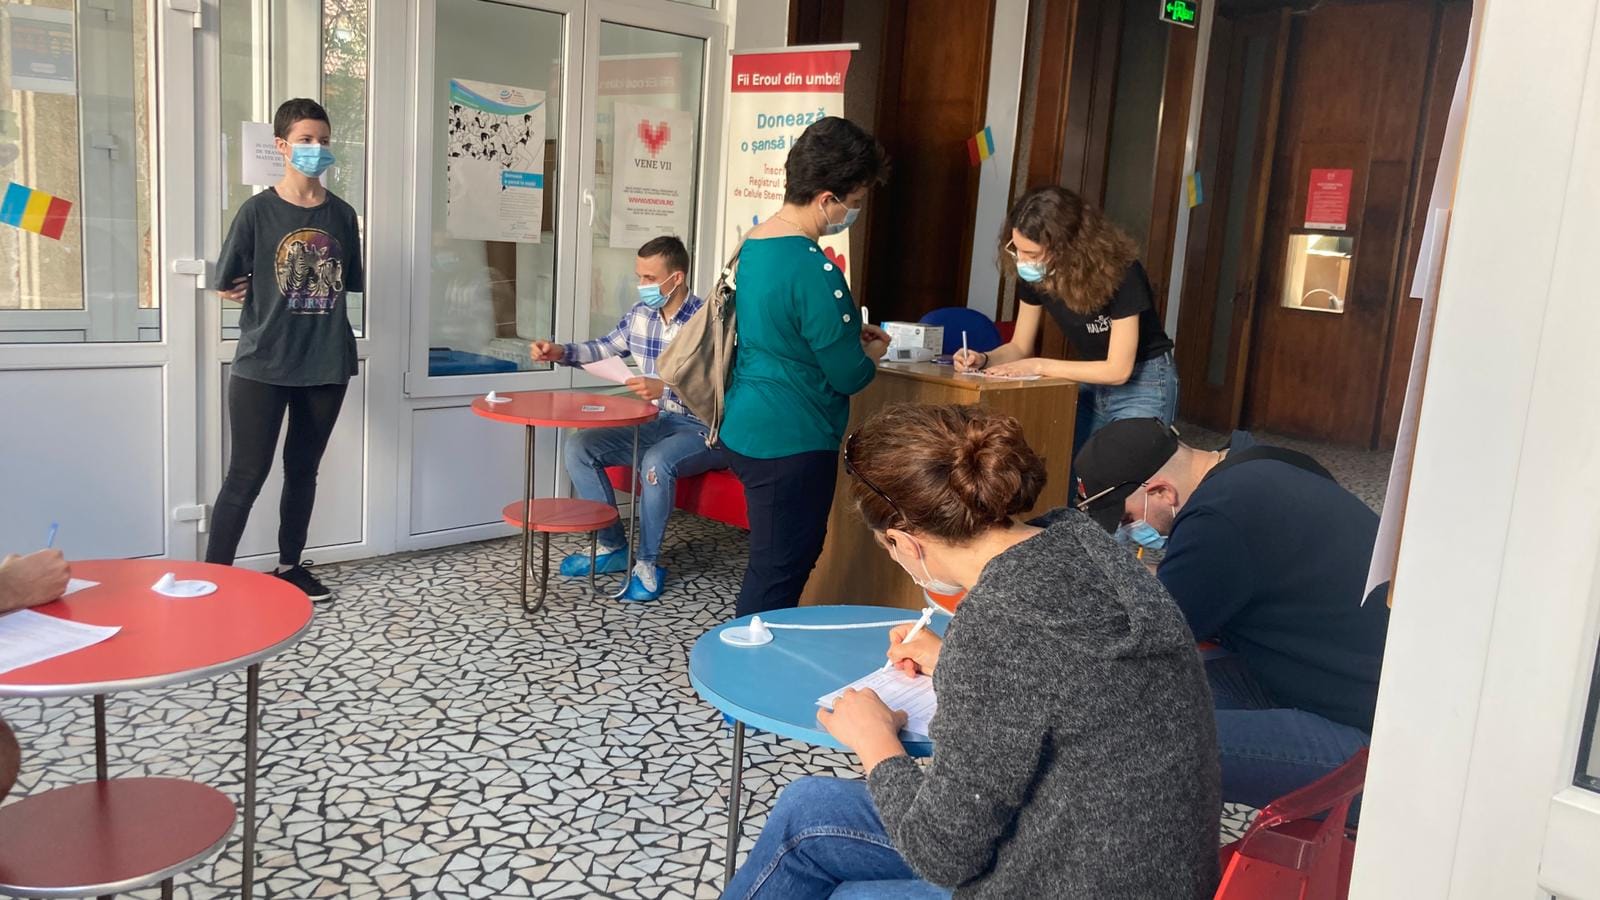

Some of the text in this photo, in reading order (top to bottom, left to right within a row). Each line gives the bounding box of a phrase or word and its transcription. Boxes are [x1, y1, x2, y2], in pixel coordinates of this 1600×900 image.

[737, 73, 750, 86] Fii
[752, 72, 782, 86] Eroul
[784, 72, 803, 85] din
[757, 107, 826, 129] Donează
[741, 141, 749, 152] o
[634, 158, 672, 171] VENE VII
[764, 163, 786, 176] Înscri
[749, 176, 781, 188] Registrul
[288, 296, 338, 309] JOURNEY
